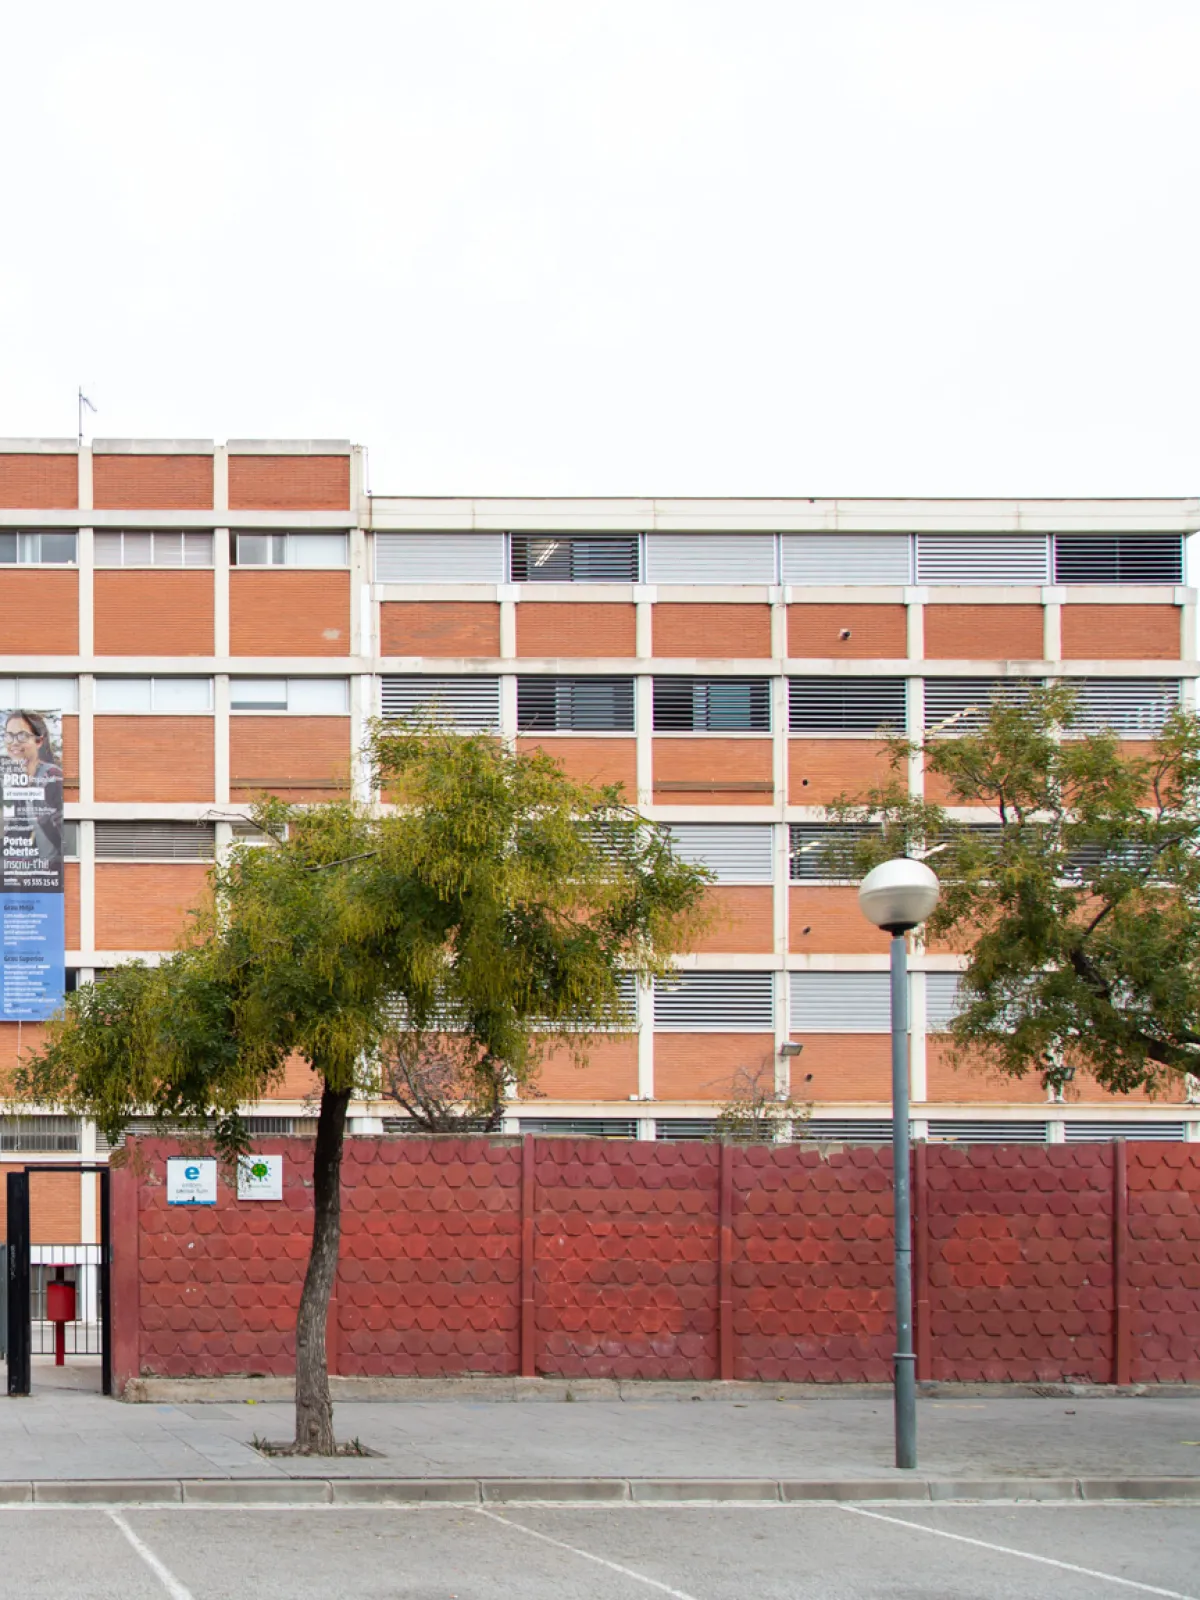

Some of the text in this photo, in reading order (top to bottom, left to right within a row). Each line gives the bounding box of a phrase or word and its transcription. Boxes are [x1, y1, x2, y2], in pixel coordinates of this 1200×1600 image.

[3, 773, 28, 786] PRO
[3, 836, 33, 846] Portes
[3, 846, 39, 856] obertes
